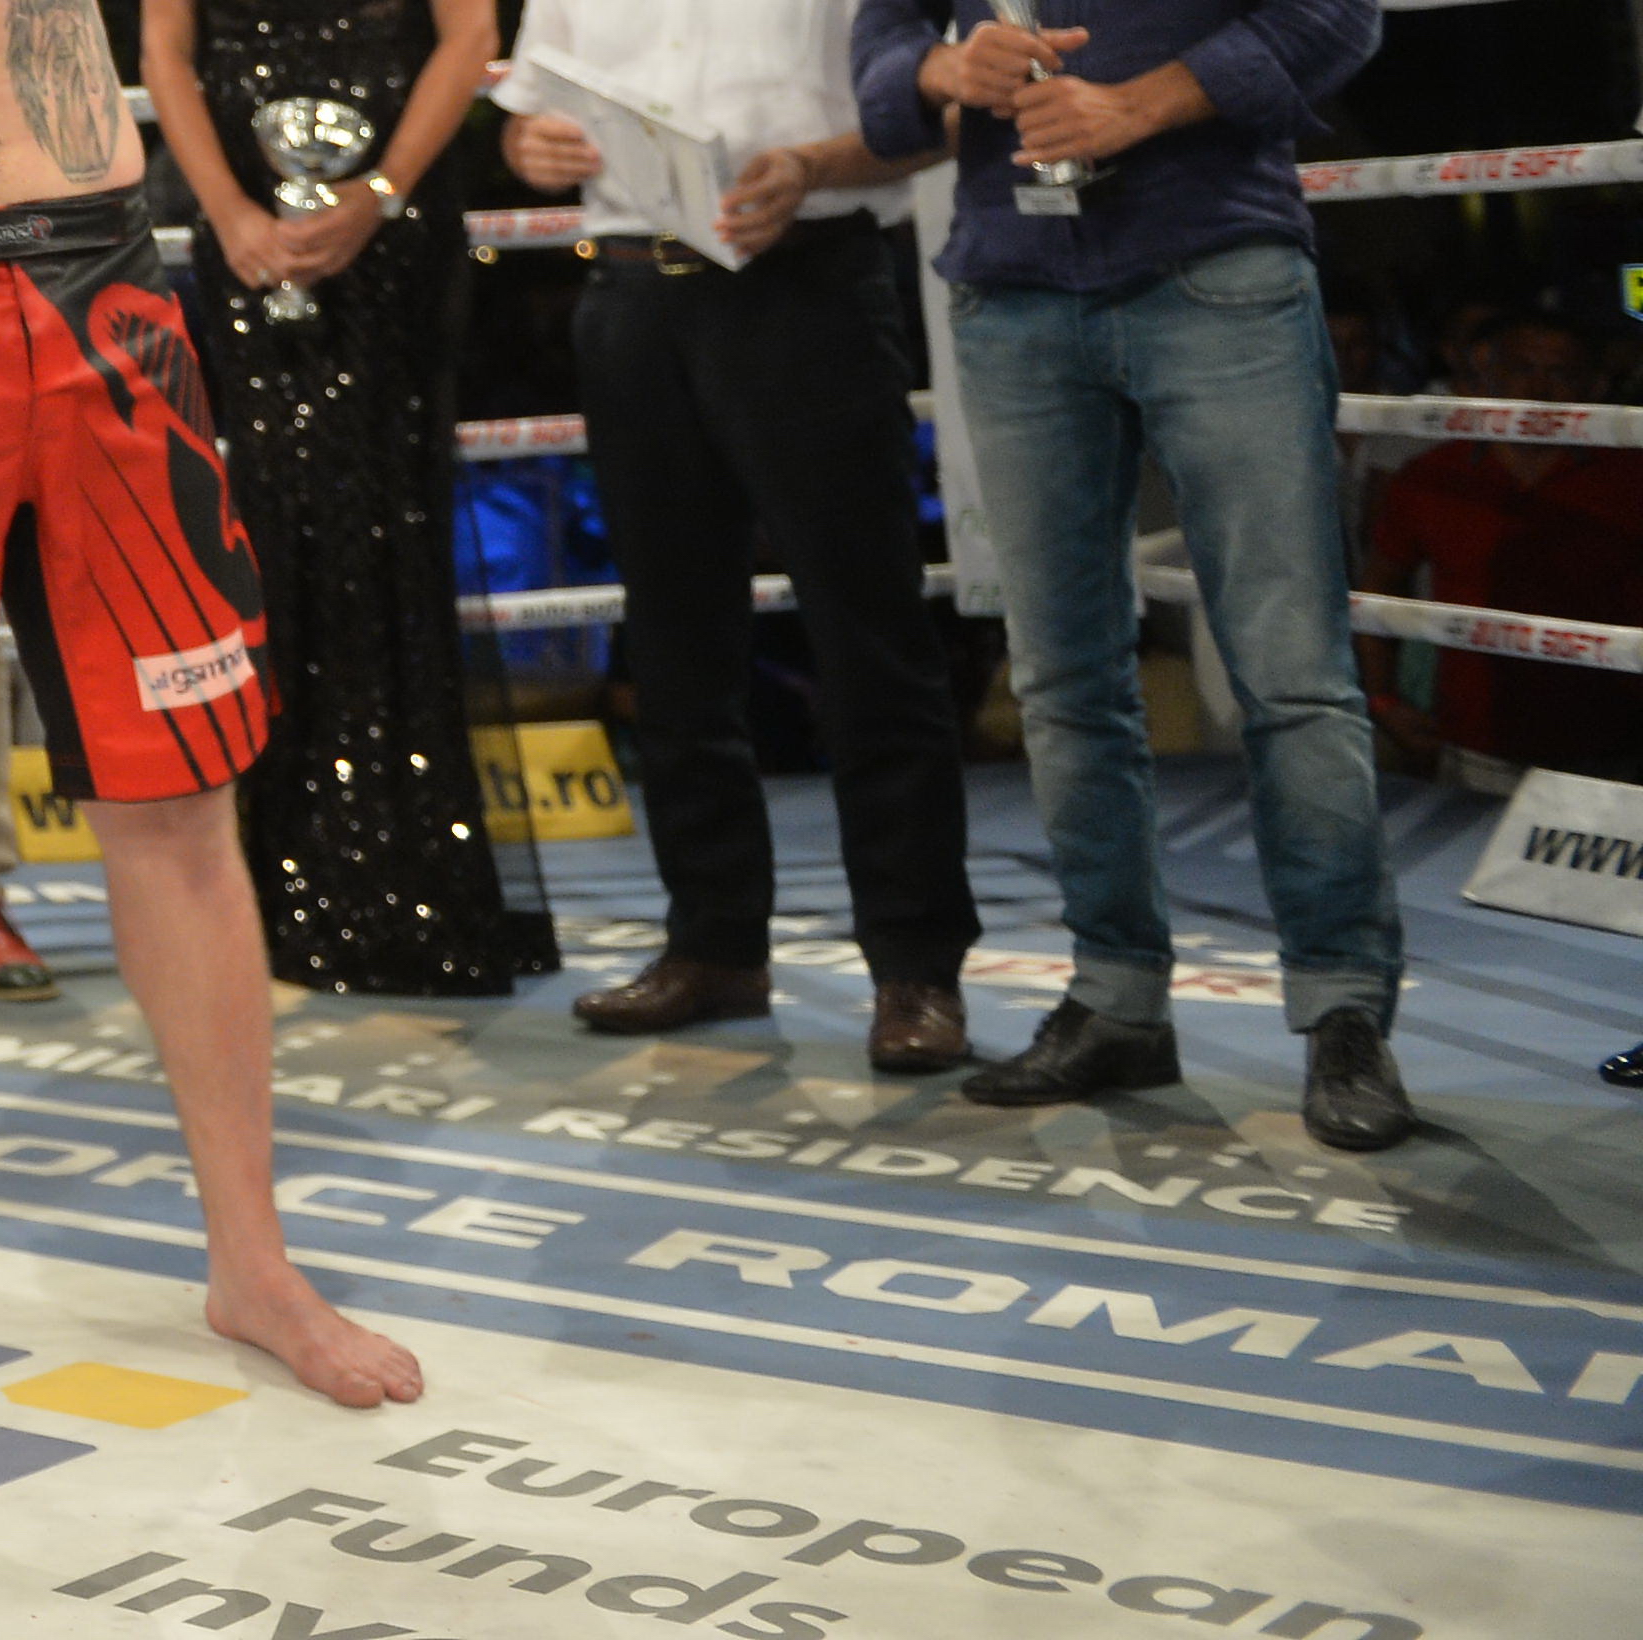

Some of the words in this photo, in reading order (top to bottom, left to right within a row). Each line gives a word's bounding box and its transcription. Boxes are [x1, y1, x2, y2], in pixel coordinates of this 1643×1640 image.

[524, 1104, 1413, 1236] RESIDENCE
[221, 1487, 850, 1640] Funds
[374, 1428, 1425, 1640] European
